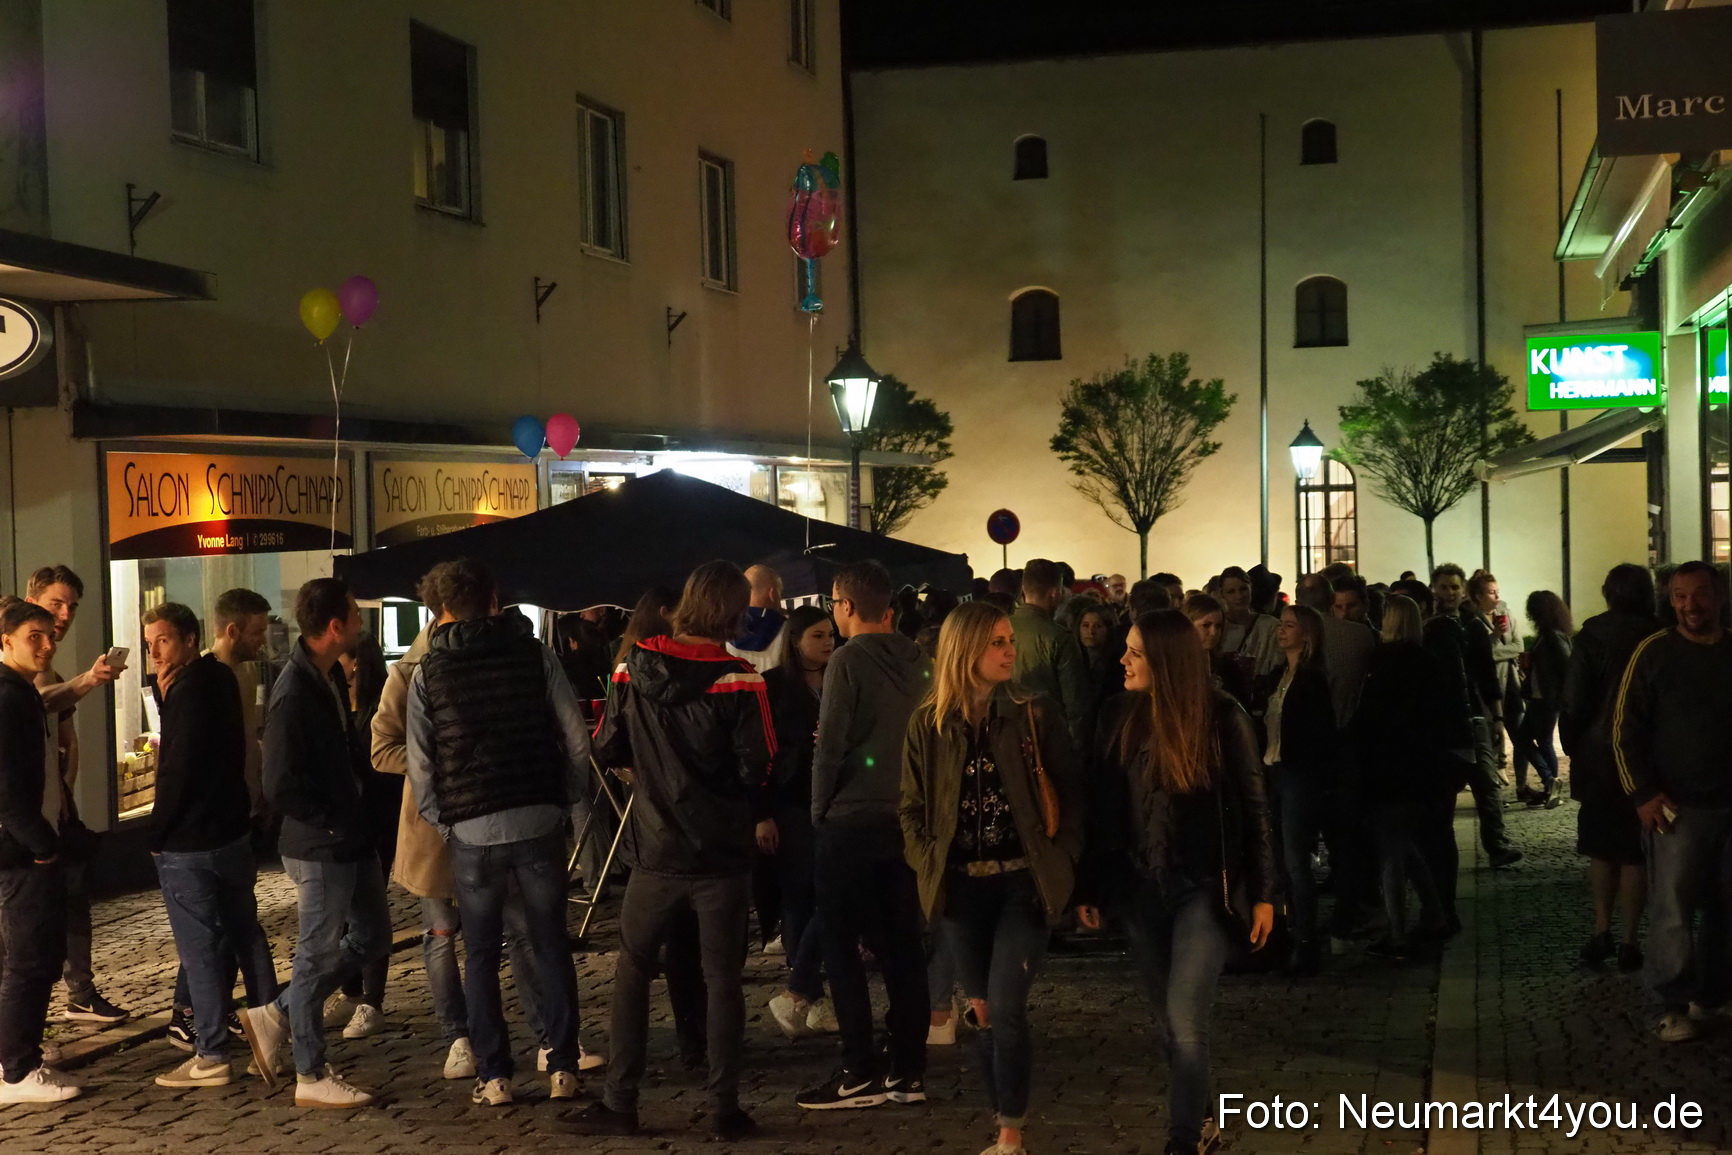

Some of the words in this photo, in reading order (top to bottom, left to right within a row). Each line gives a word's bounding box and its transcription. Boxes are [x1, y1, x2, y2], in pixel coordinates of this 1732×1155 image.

[1615, 93, 1726, 120] Marc
[1531, 344, 1629, 375] KUNST
[197, 534, 225, 549] Yvonne
[225, 533, 243, 550] Lang
[259, 532, 284, 546] 299616
